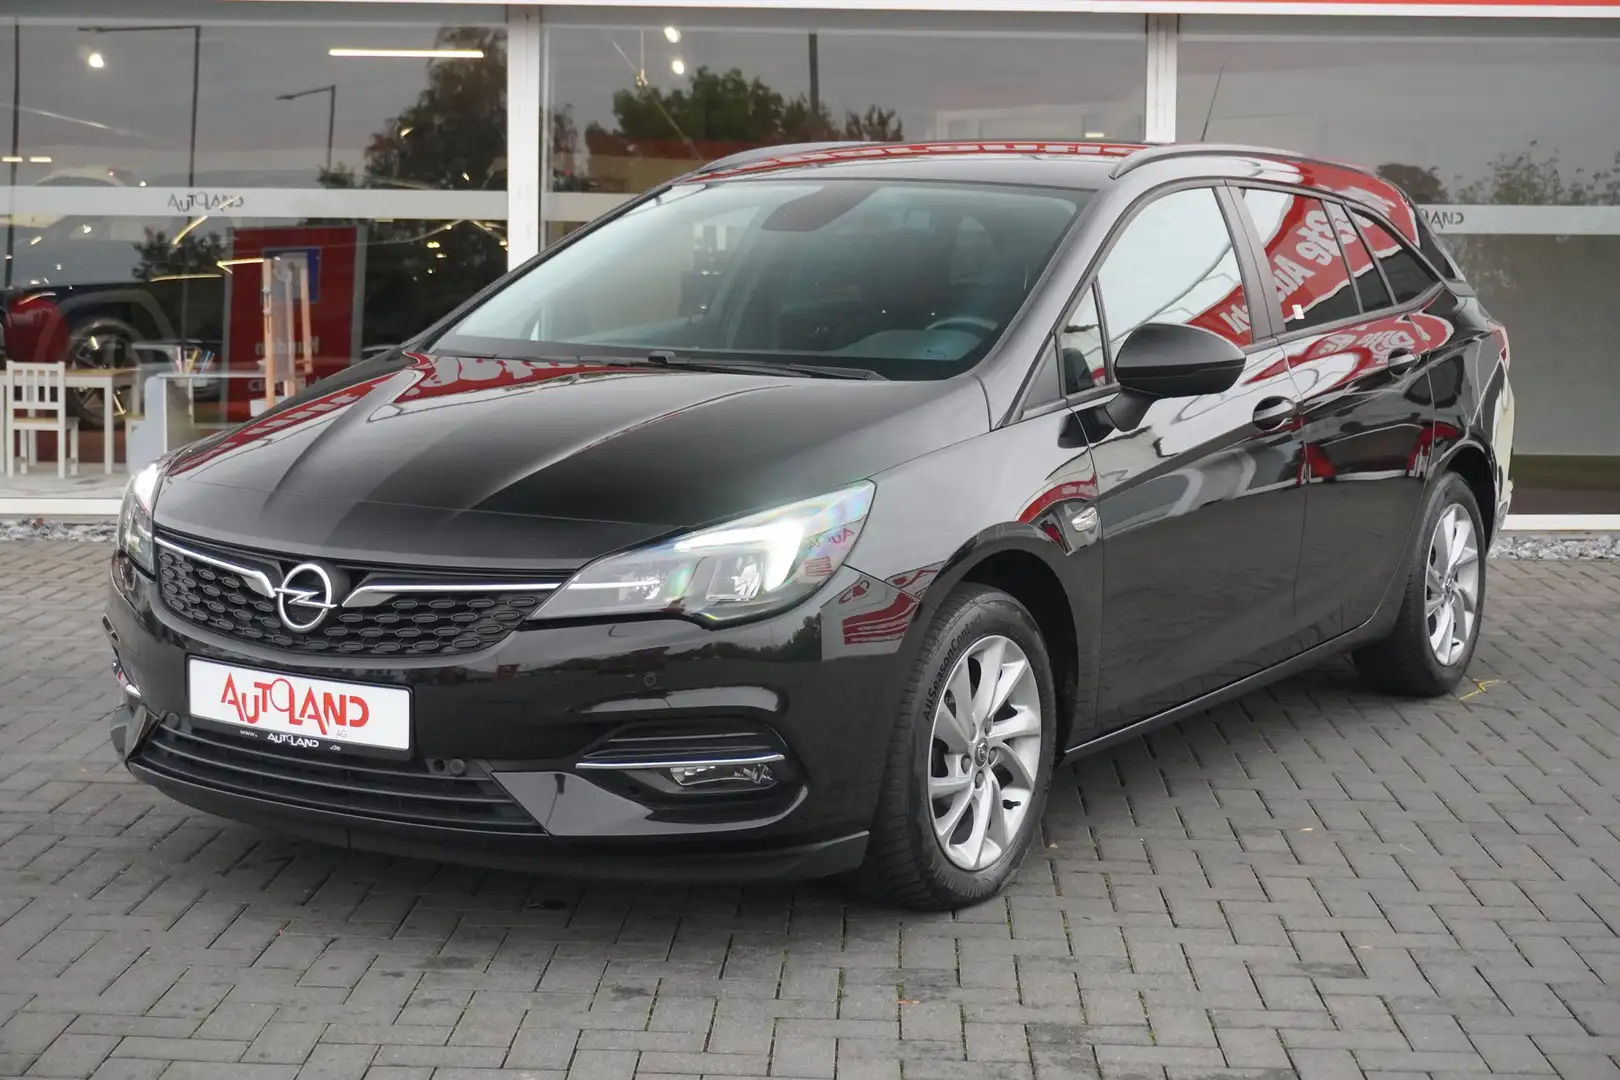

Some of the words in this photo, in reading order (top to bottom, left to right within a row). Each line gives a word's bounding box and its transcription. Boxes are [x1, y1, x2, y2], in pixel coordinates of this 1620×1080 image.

[221, 673, 369, 735] AUTOLAND
[267, 732, 320, 748] AUTOLAND
[336, 729, 348, 738] AG
